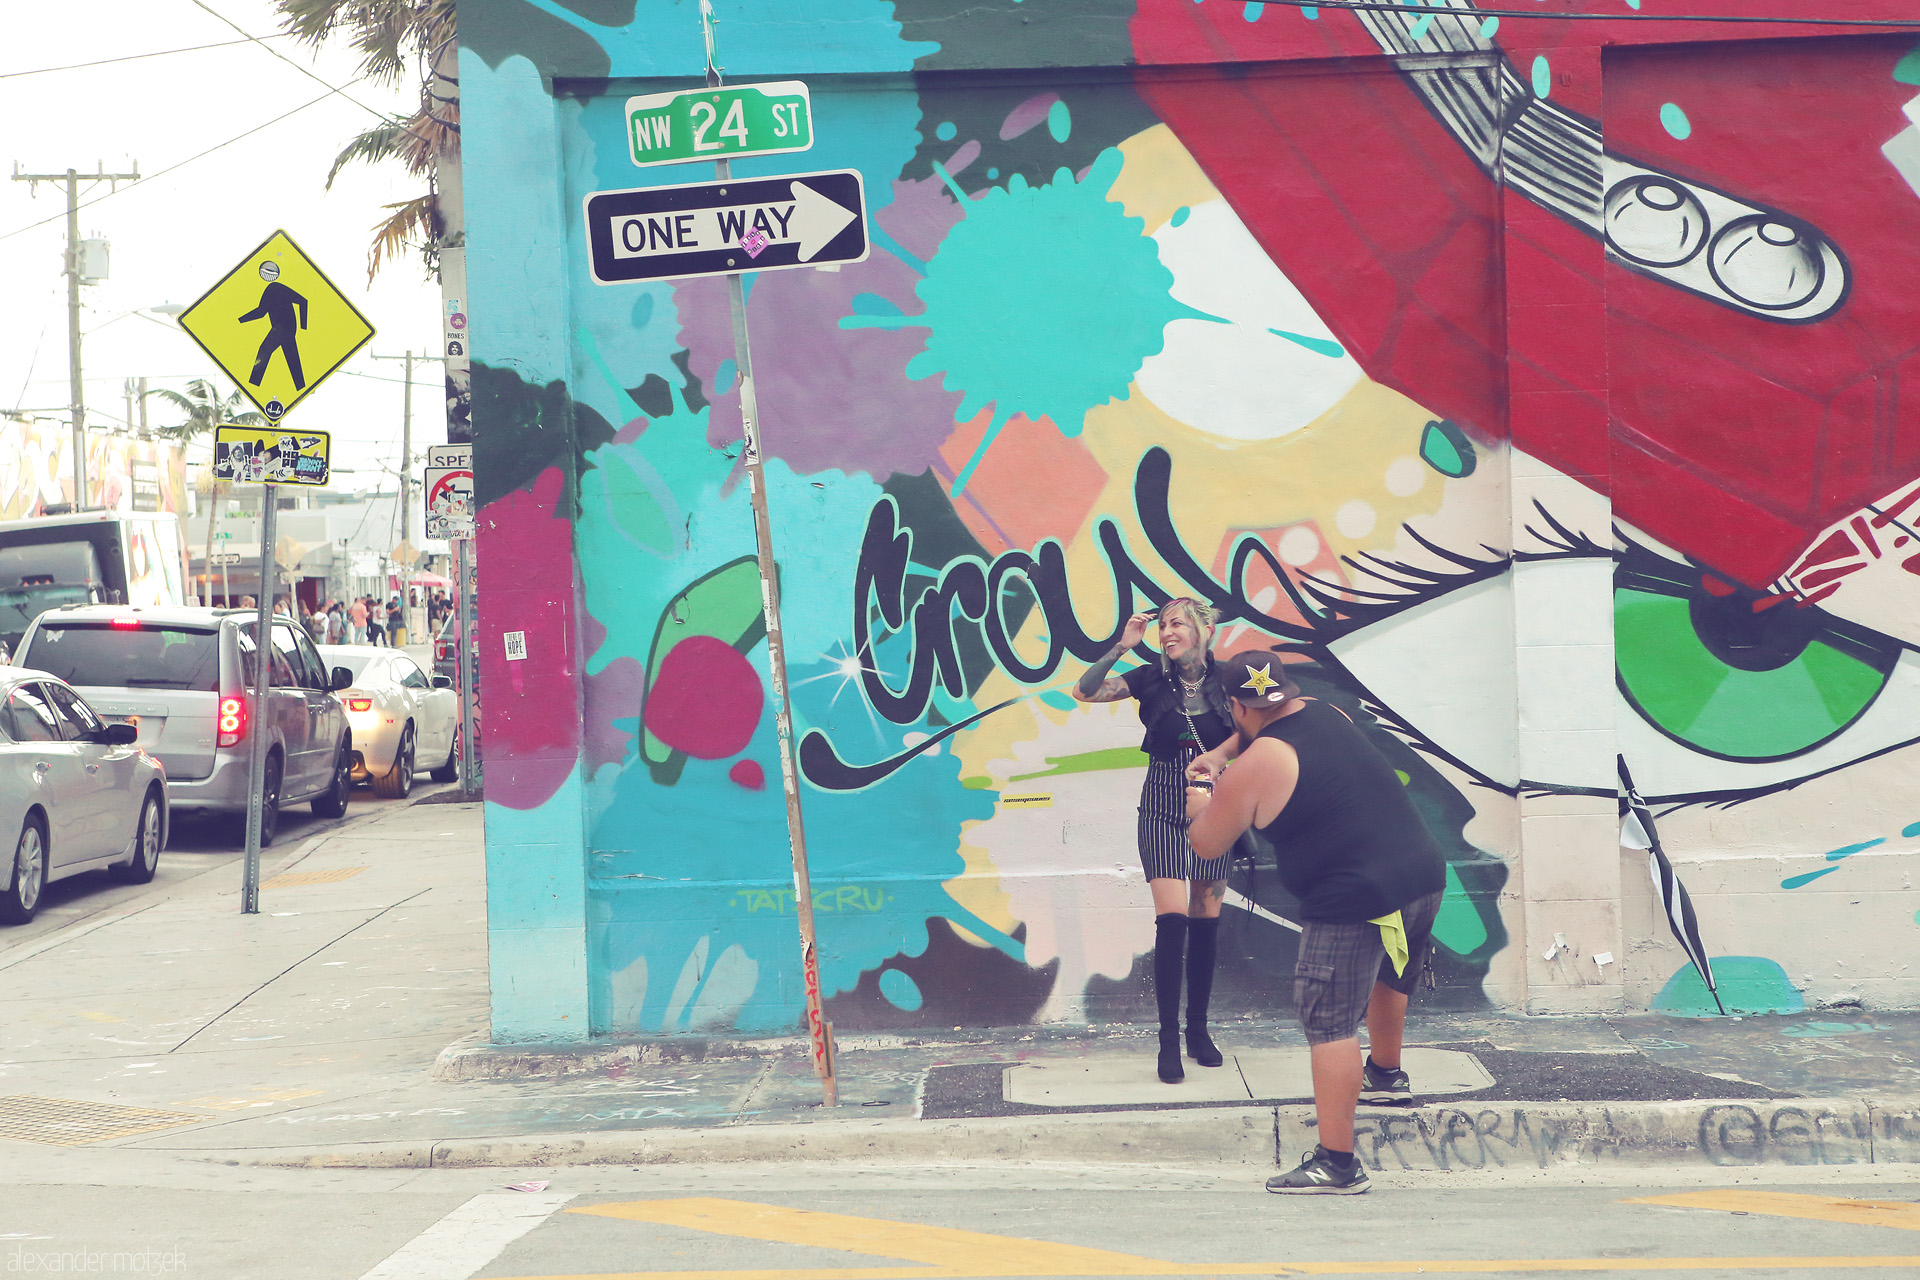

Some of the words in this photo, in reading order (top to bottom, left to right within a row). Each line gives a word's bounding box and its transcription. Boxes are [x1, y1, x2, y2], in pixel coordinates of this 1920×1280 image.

[635, 115, 671, 151] NW
[689, 98, 749, 152] 24
[771, 102, 800, 138] ST
[621, 214, 699, 253] ONE
[716, 205, 796, 244] WAY
[447, 332, 465, 340] BONES
[434, 454, 473, 468] SPE
[507, 640, 523, 655] HOPE
